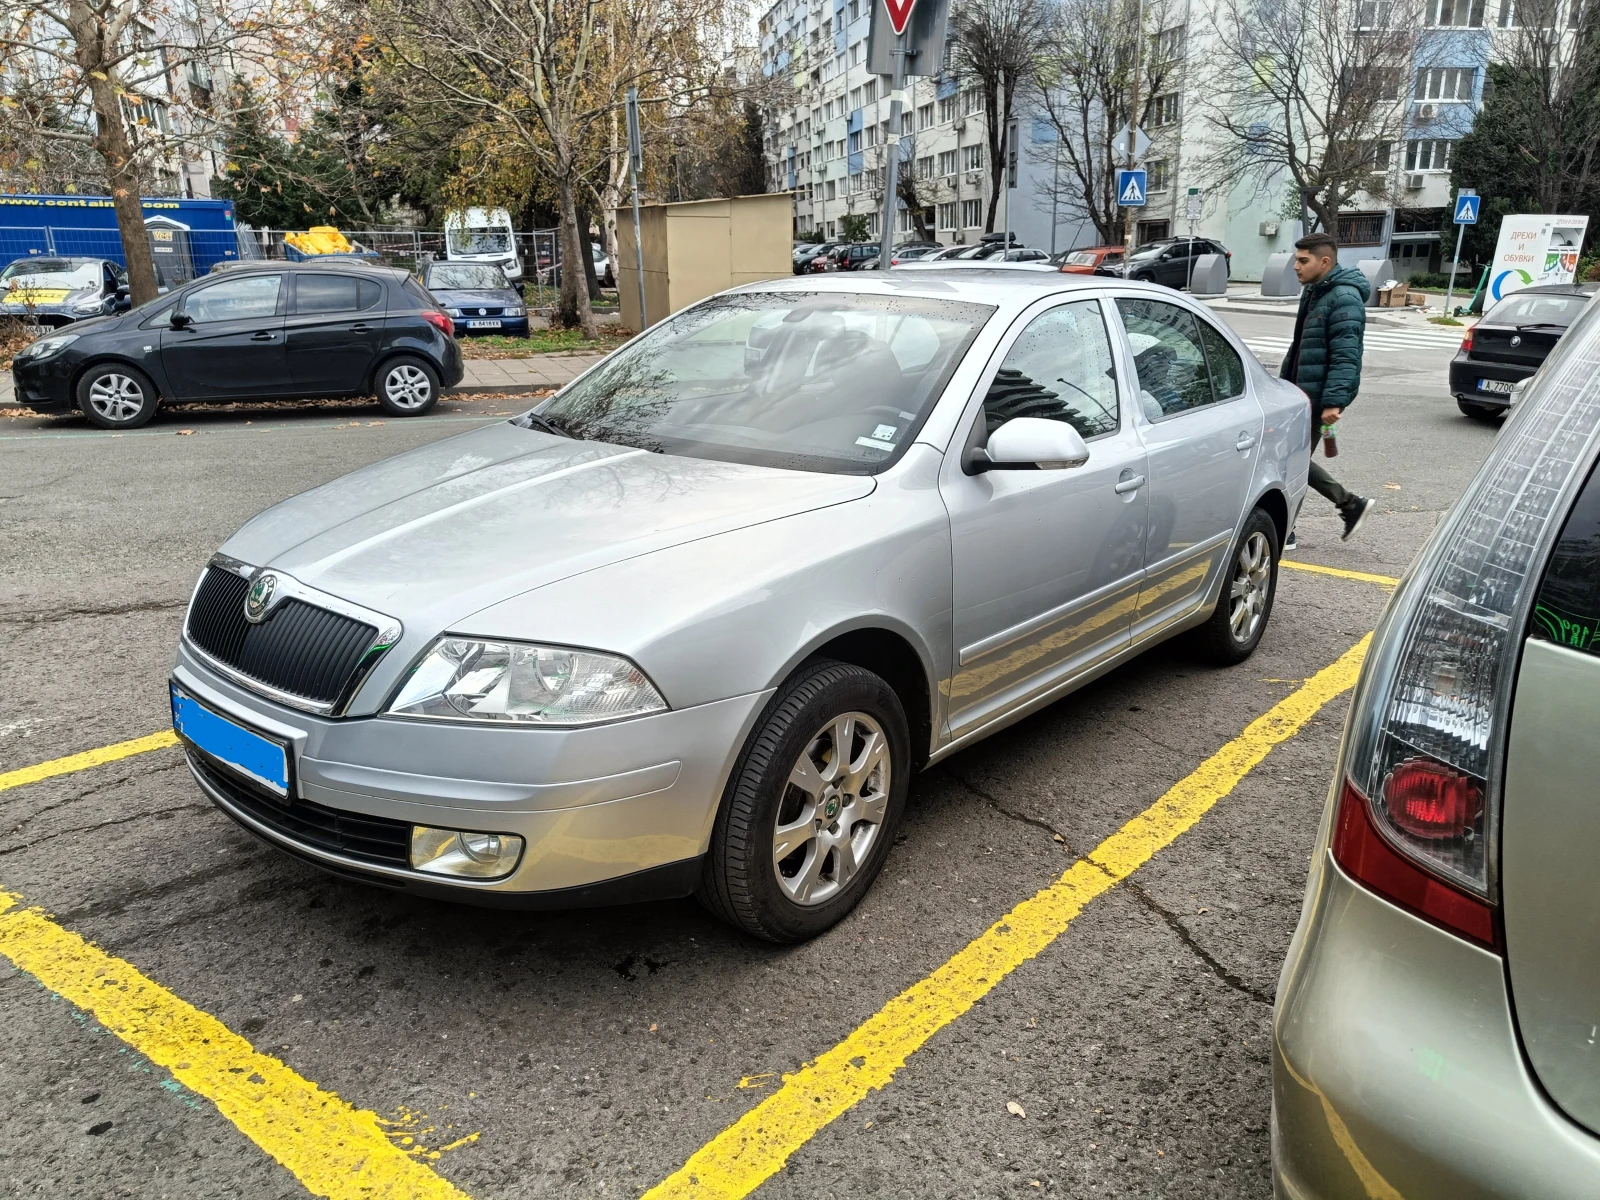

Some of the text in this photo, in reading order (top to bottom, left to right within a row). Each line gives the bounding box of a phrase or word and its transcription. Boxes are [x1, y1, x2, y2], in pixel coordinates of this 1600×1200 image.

[1510, 231, 1537, 240] ДРЕХИ
[1518, 243, 1525, 251] И
[1503, 254, 1534, 263] ОБУВКИ
